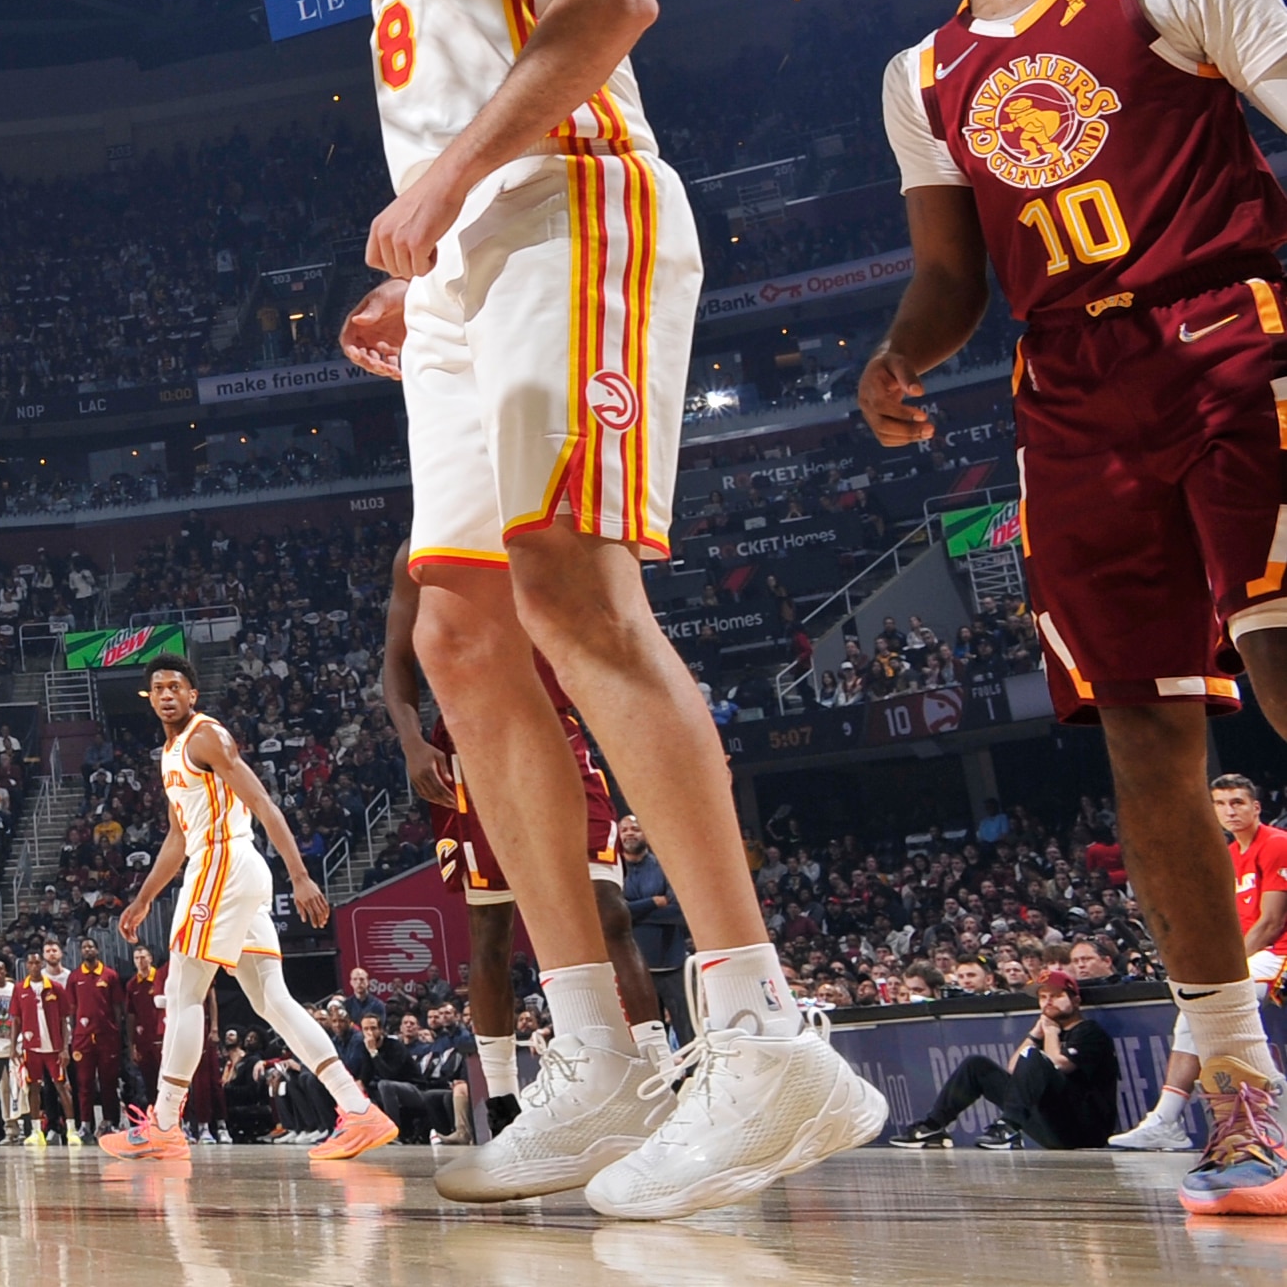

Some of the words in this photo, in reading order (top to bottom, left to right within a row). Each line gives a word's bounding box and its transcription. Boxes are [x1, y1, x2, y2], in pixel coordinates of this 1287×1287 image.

[962, 53, 1122, 157] CAVALIERS
[988, 119, 1108, 188] CLEVELAND
[1018, 179, 1131, 277] 10
[806, 271, 867, 293] Opens
[216, 379, 267, 396] make
[272, 366, 340, 389] friends
[79, 399, 107, 414] LAC
[350, 497, 386, 512] M103
[782, 529, 837, 549] Homes
[971, 682, 1002, 699] FOULS
[986, 698, 996, 720] 1
[768, 726, 813, 749] 5:07
[842, 722, 852, 737] 9
[884, 705, 912, 737] 10
